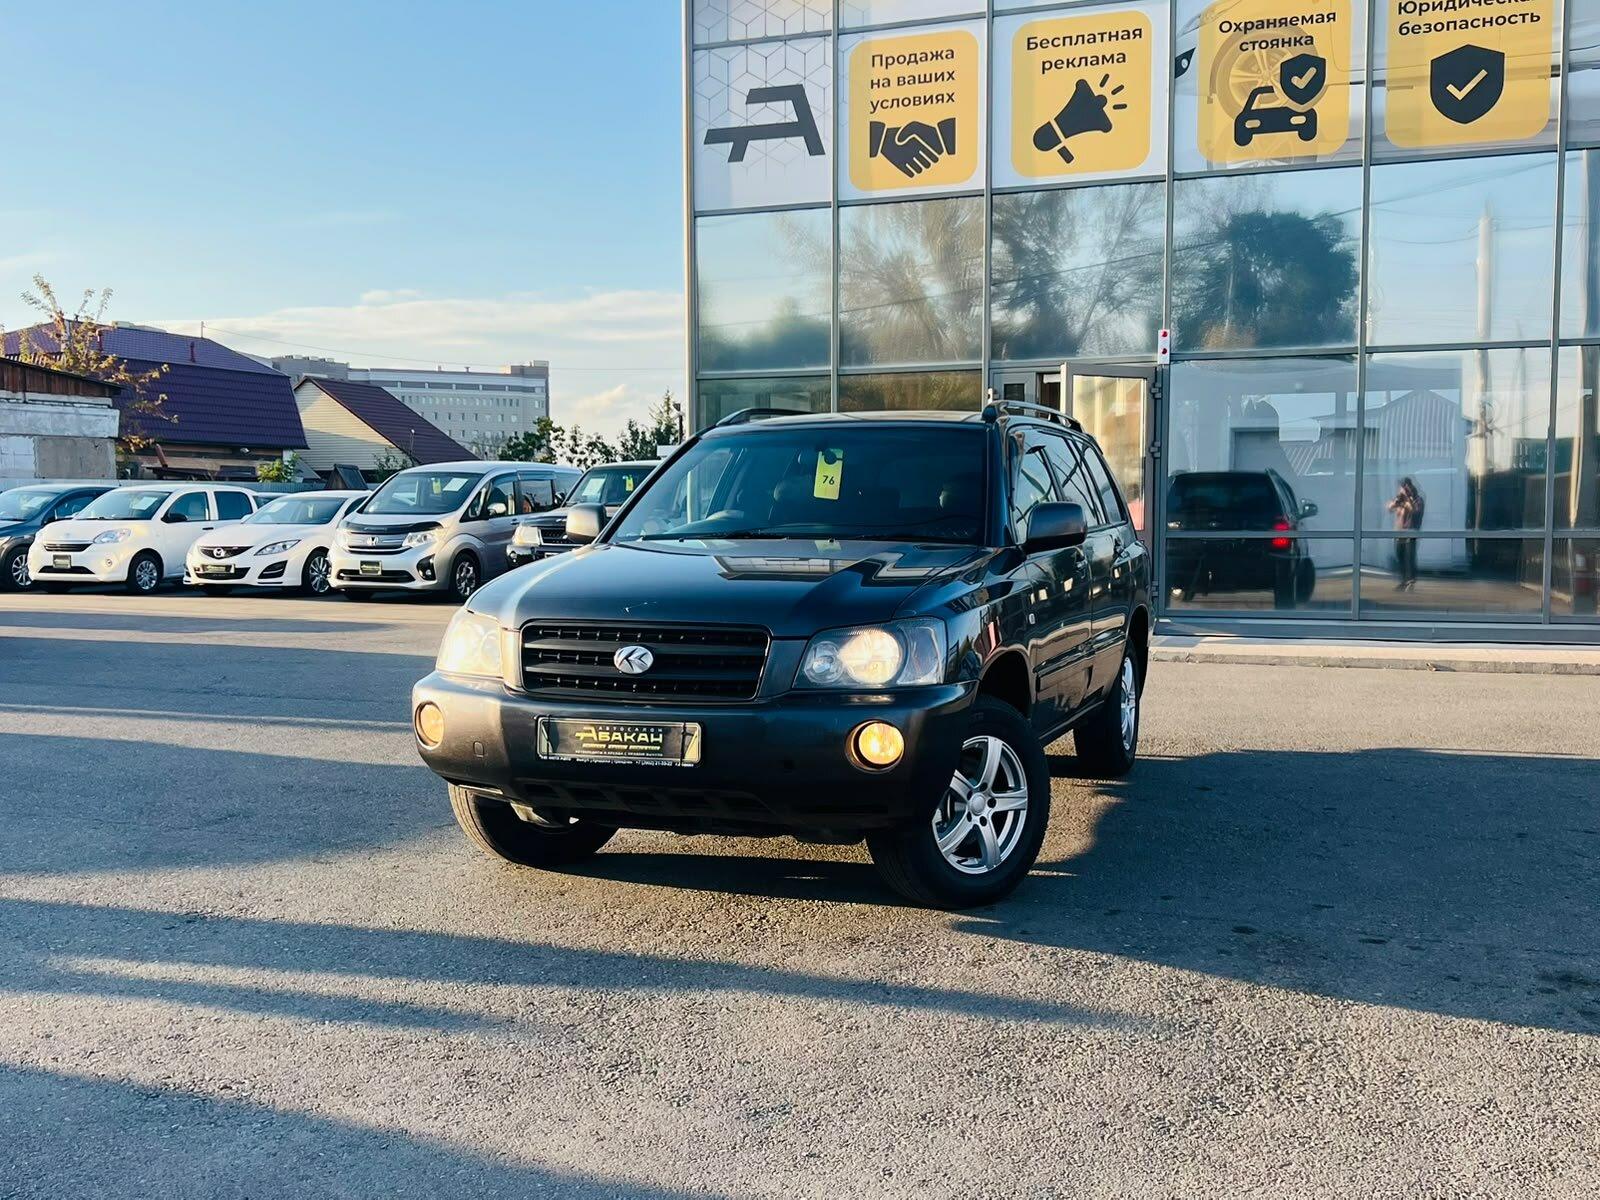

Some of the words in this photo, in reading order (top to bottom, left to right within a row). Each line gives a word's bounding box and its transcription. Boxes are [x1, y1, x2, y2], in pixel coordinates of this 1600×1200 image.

[1397, 0, 1530, 16] Юридиче
[1218, 11, 1337, 34] Охраняемая
[1398, 12, 1541, 36] безопасность
[1026, 27, 1143, 51] Бесплатная
[1239, 34, 1314, 52] стоянка
[871, 48, 955, 70] Продажа
[1041, 51, 1127, 75] реклама
[870, 77, 891, 90] на
[896, 70, 956, 87] ваших
[869, 92, 956, 115] условиях
[822, 474, 835, 486] 76
